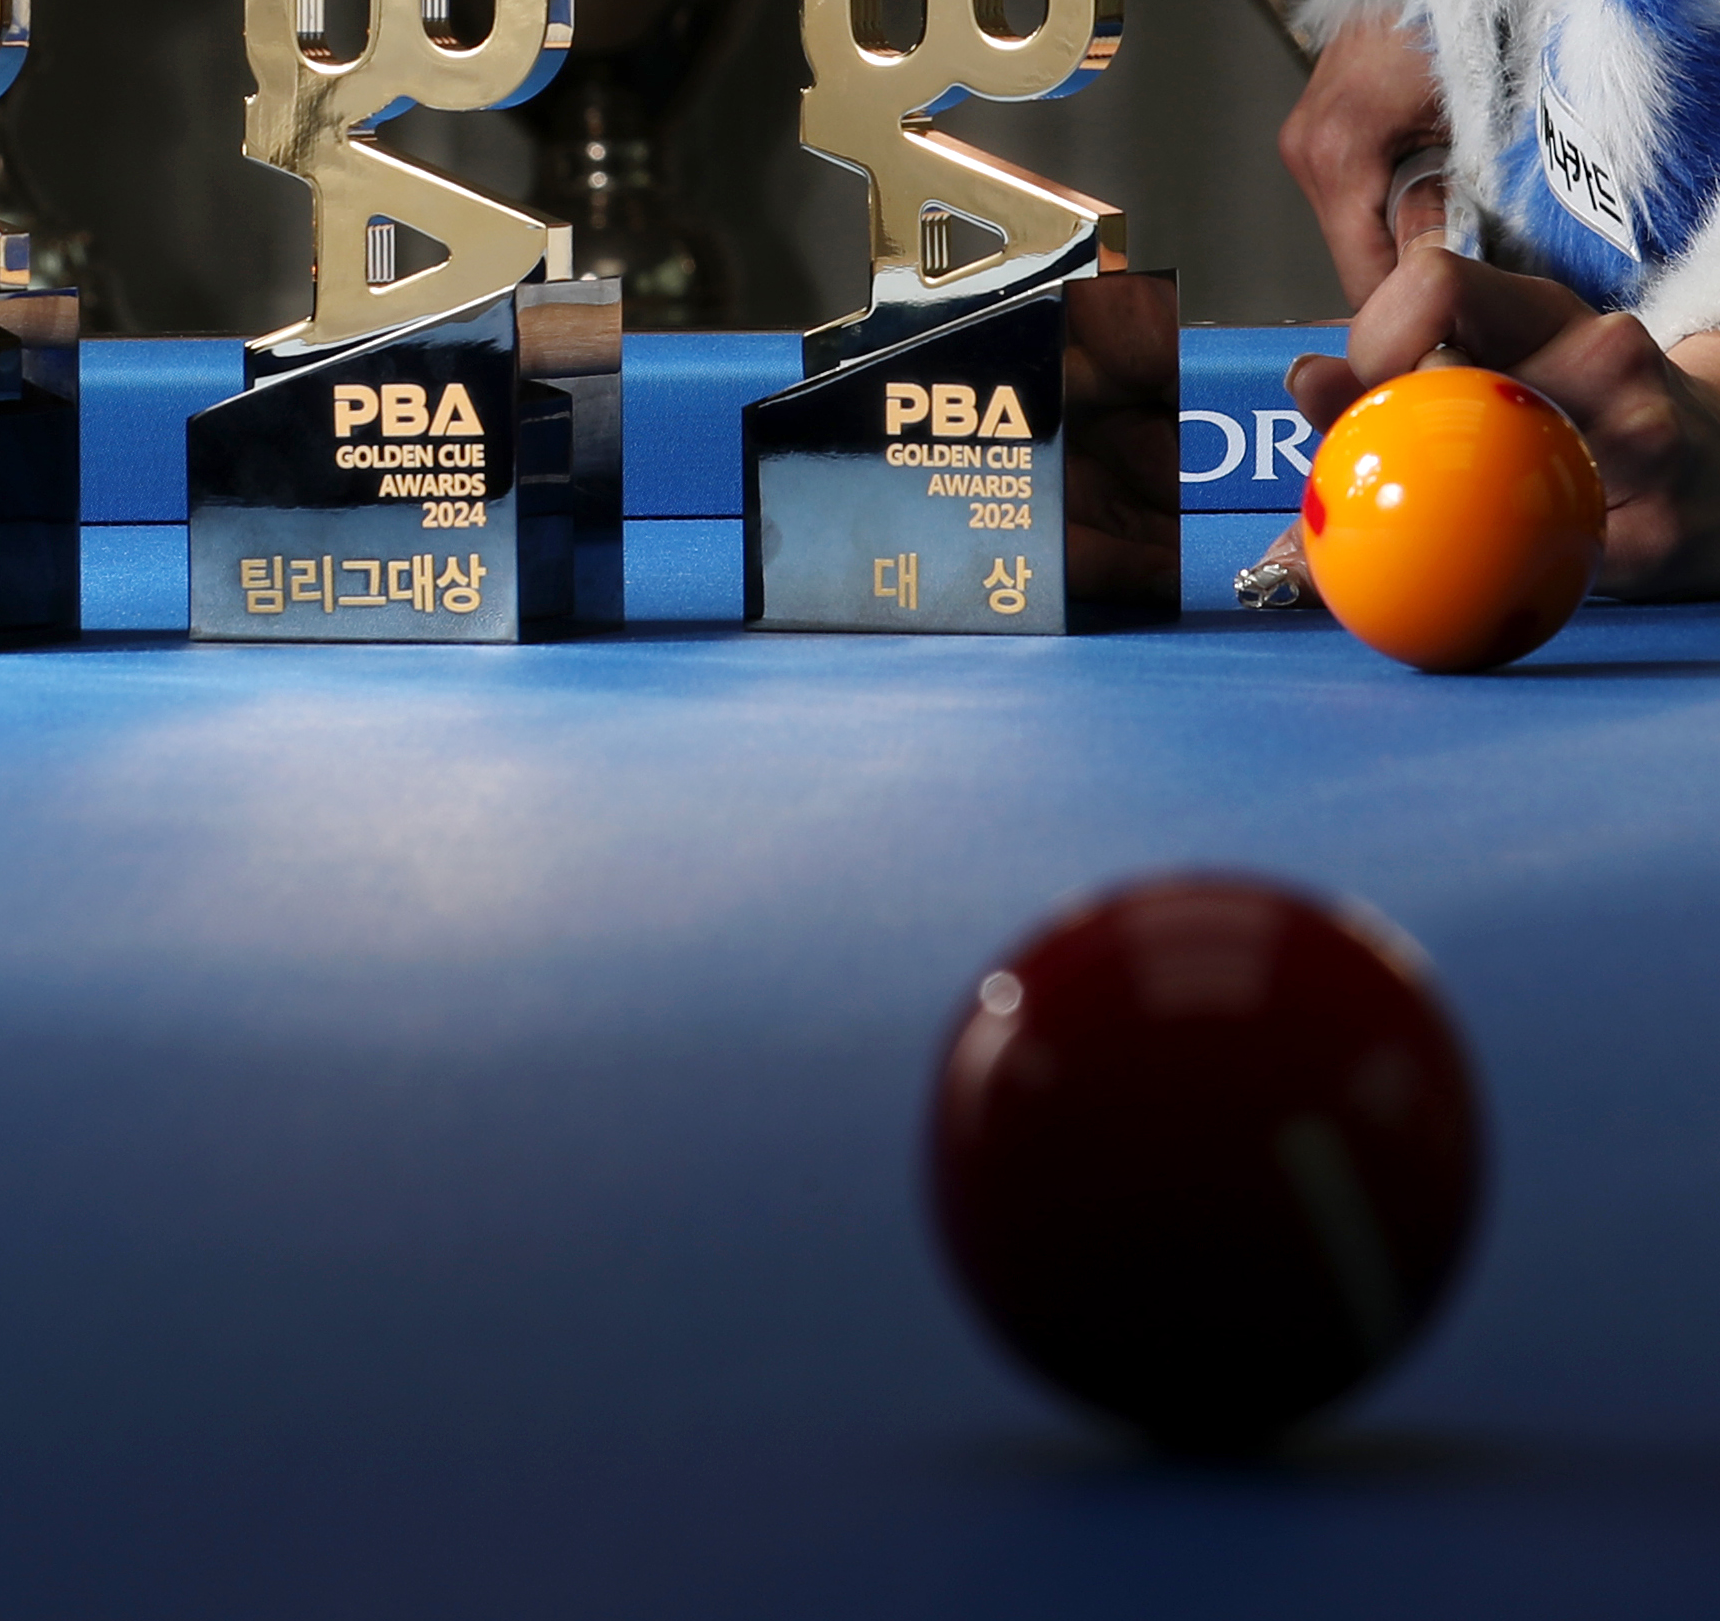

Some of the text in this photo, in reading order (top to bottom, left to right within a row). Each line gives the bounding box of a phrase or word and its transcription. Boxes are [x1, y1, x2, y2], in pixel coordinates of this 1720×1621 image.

[334, 383, 485, 438] PBA
[886, 383, 1032, 439] PBA
[336, 444, 486, 469] GOLDEN CUE
[886, 443, 1032, 469] GOLDEN CUE
[379, 473, 487, 497] AWARDS
[928, 475, 1033, 499] AWARDS
[422, 501, 487, 528] 2024
[969, 504, 1033, 530] 2024
[240, 554, 487, 614] 팀리그대상
